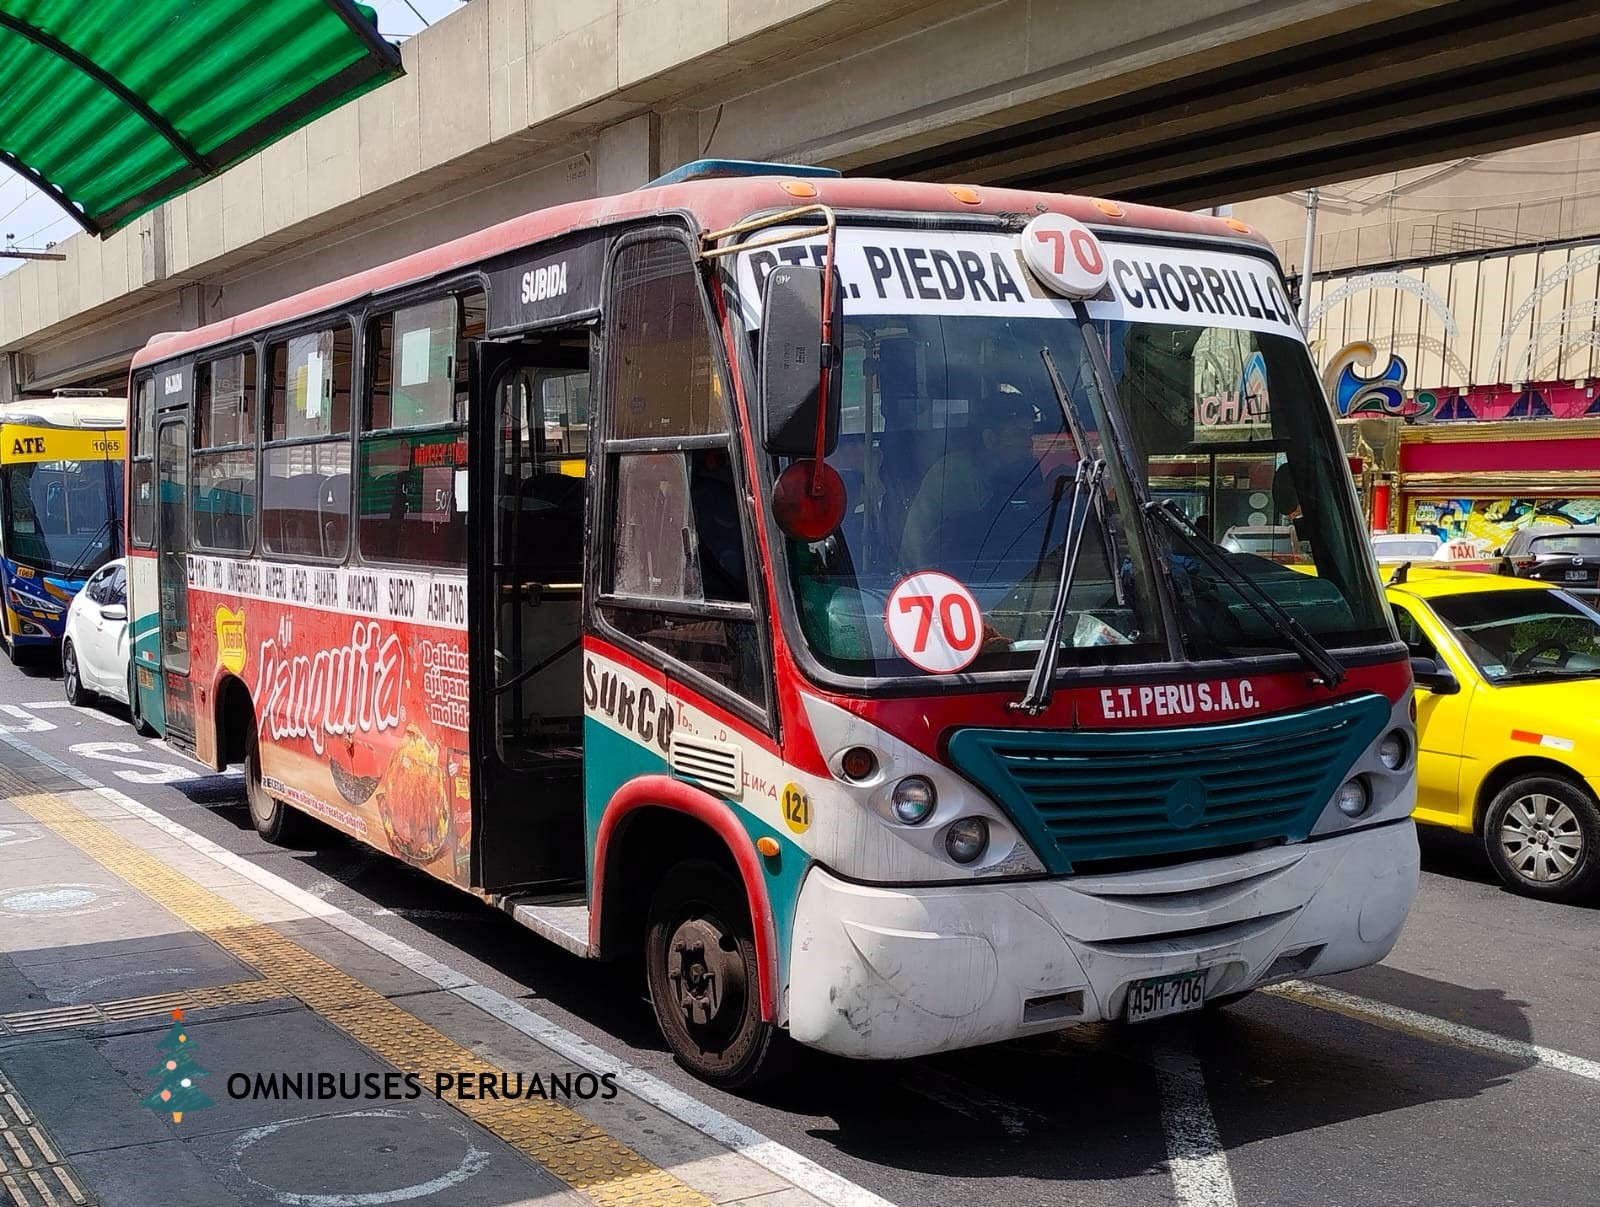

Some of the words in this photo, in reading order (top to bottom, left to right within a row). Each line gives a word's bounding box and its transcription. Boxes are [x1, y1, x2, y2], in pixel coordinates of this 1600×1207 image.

[862, 245, 1025, 303] PIEDRA
[1034, 229, 1104, 276] 70
[521, 261, 567, 304] SUBIDA
[1112, 258, 1300, 333] CHORRILLO
[12, 437, 46, 455] ATE
[93, 441, 120, 452] 1065
[1450, 545, 1476, 560] TAXI
[346, 574, 379, 613] AVIACION
[388, 577, 415, 618] SURCO
[898, 593, 977, 653] 70
[584, 658, 675, 753] SURCO
[1100, 688, 1138, 719] E.T.
[1139, 684, 1195, 717] PERU
[1197, 679, 1261, 712] S.A.C.
[785, 790, 809, 825] 121
[1130, 975, 1203, 1016] A5M-706
